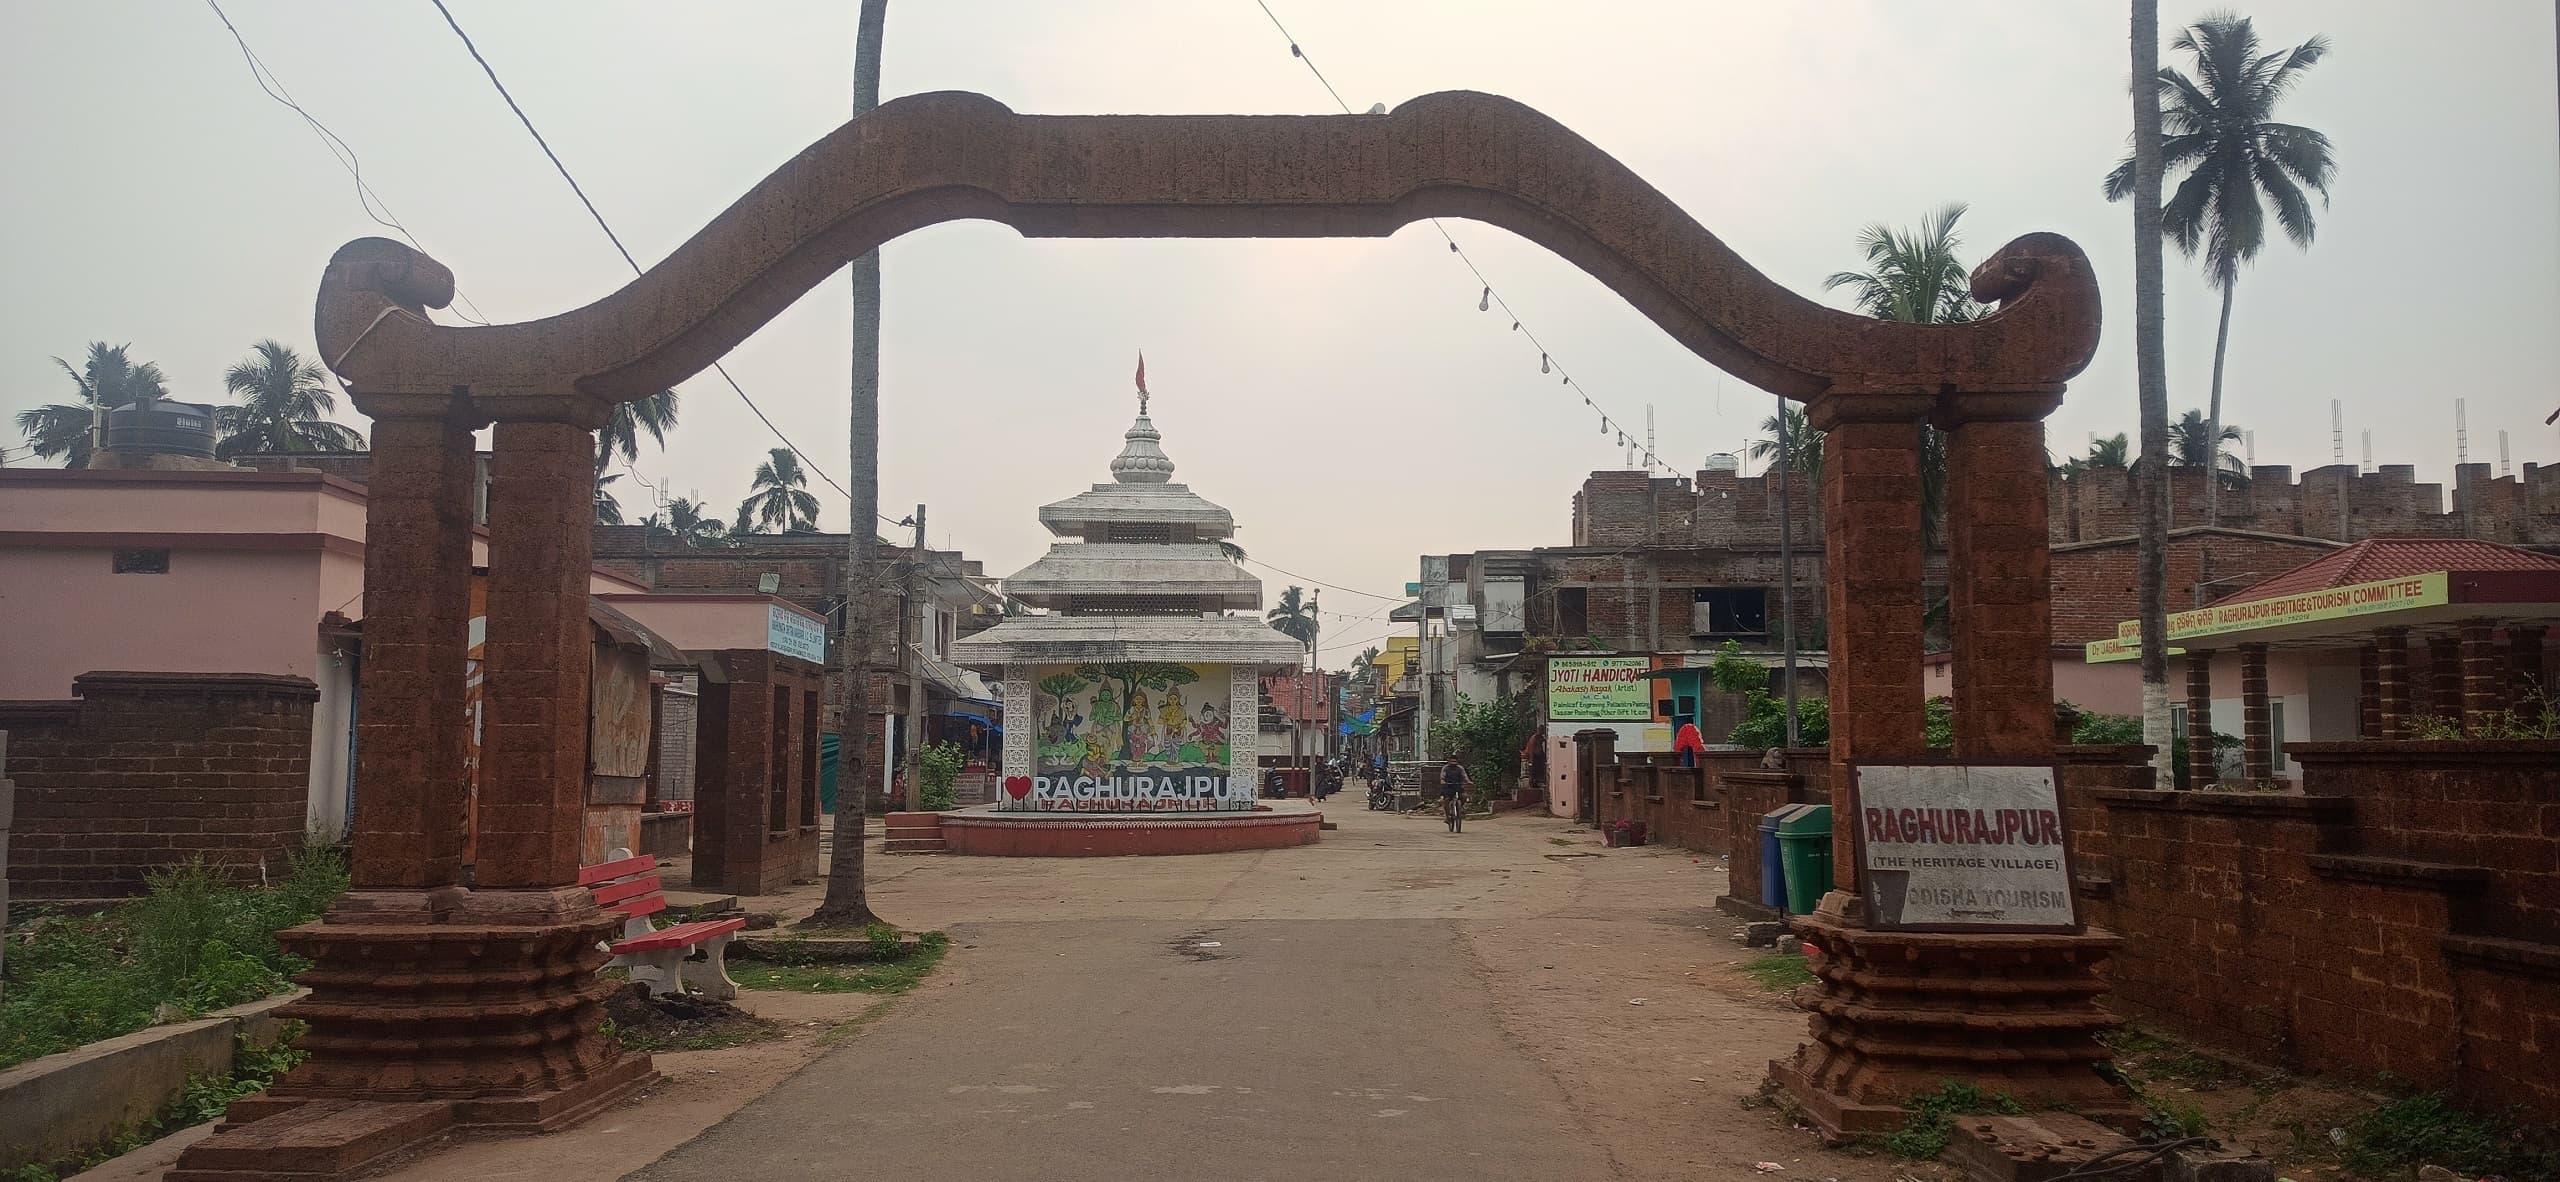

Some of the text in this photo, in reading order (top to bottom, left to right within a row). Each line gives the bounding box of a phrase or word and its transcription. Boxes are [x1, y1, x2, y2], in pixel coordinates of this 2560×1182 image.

[2218, 603, 2270, 624] RAGHURAJPUR
[2353, 580, 2423, 604] COMMITTEE
[1551, 669, 1579, 682] JYOTI
[996, 776, 1002, 801] I
[1033, 776, 1251, 801] RAGHURAJPUR
[1866, 808, 2063, 845] RAGHURAJPUR
[1873, 857, 2059, 872] (THE HERITAGE VILLAGE)
[1908, 888, 2067, 909] ODISHA TOURISM
